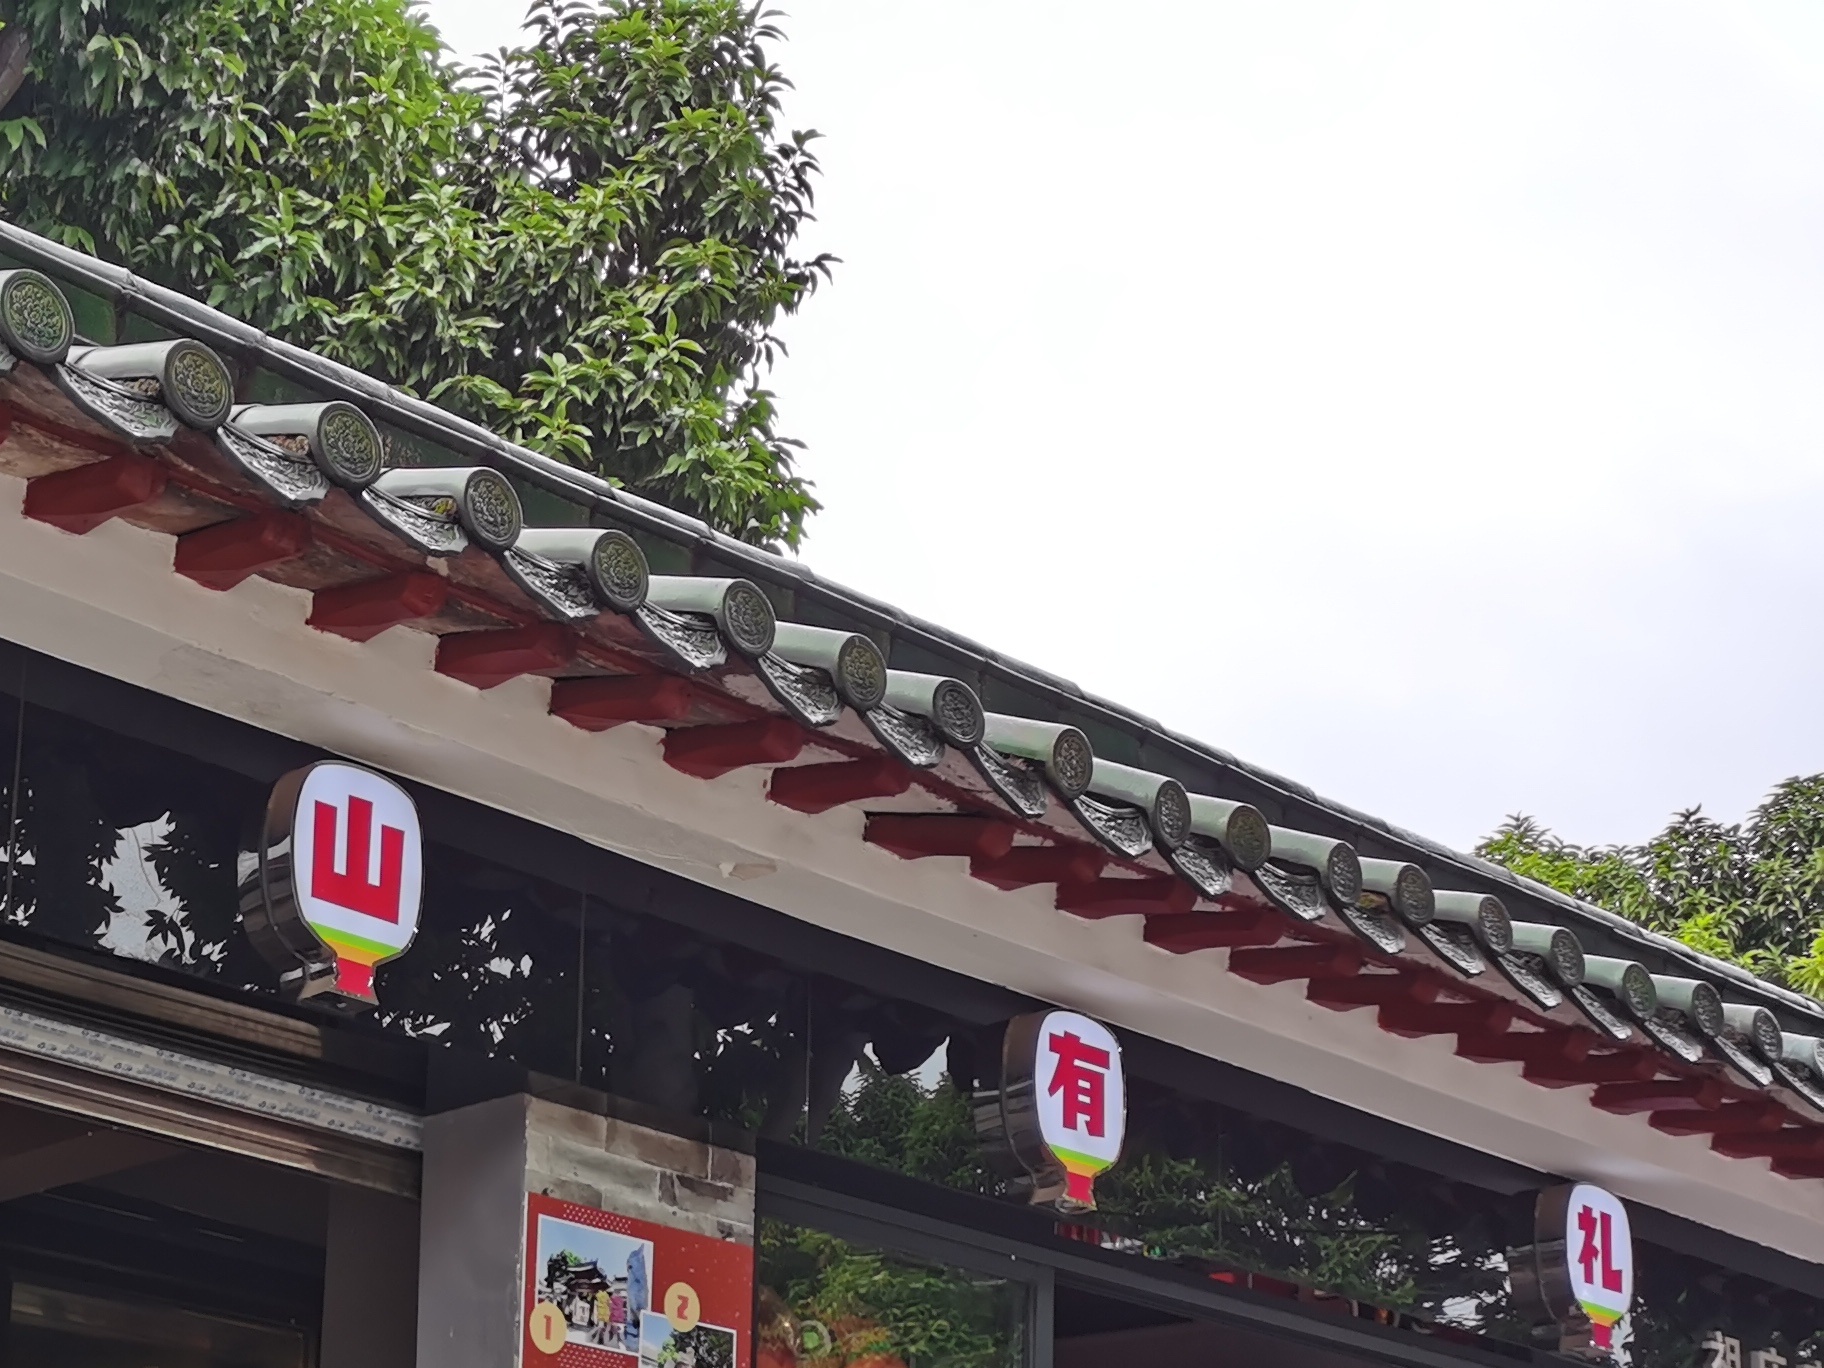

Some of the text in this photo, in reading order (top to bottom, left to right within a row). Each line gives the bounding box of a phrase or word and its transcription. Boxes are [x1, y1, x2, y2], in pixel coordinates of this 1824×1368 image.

[311, 794, 405, 926] 山
[1047, 1030, 1111, 1138] 有
[1577, 1204, 1623, 1294] 礼
